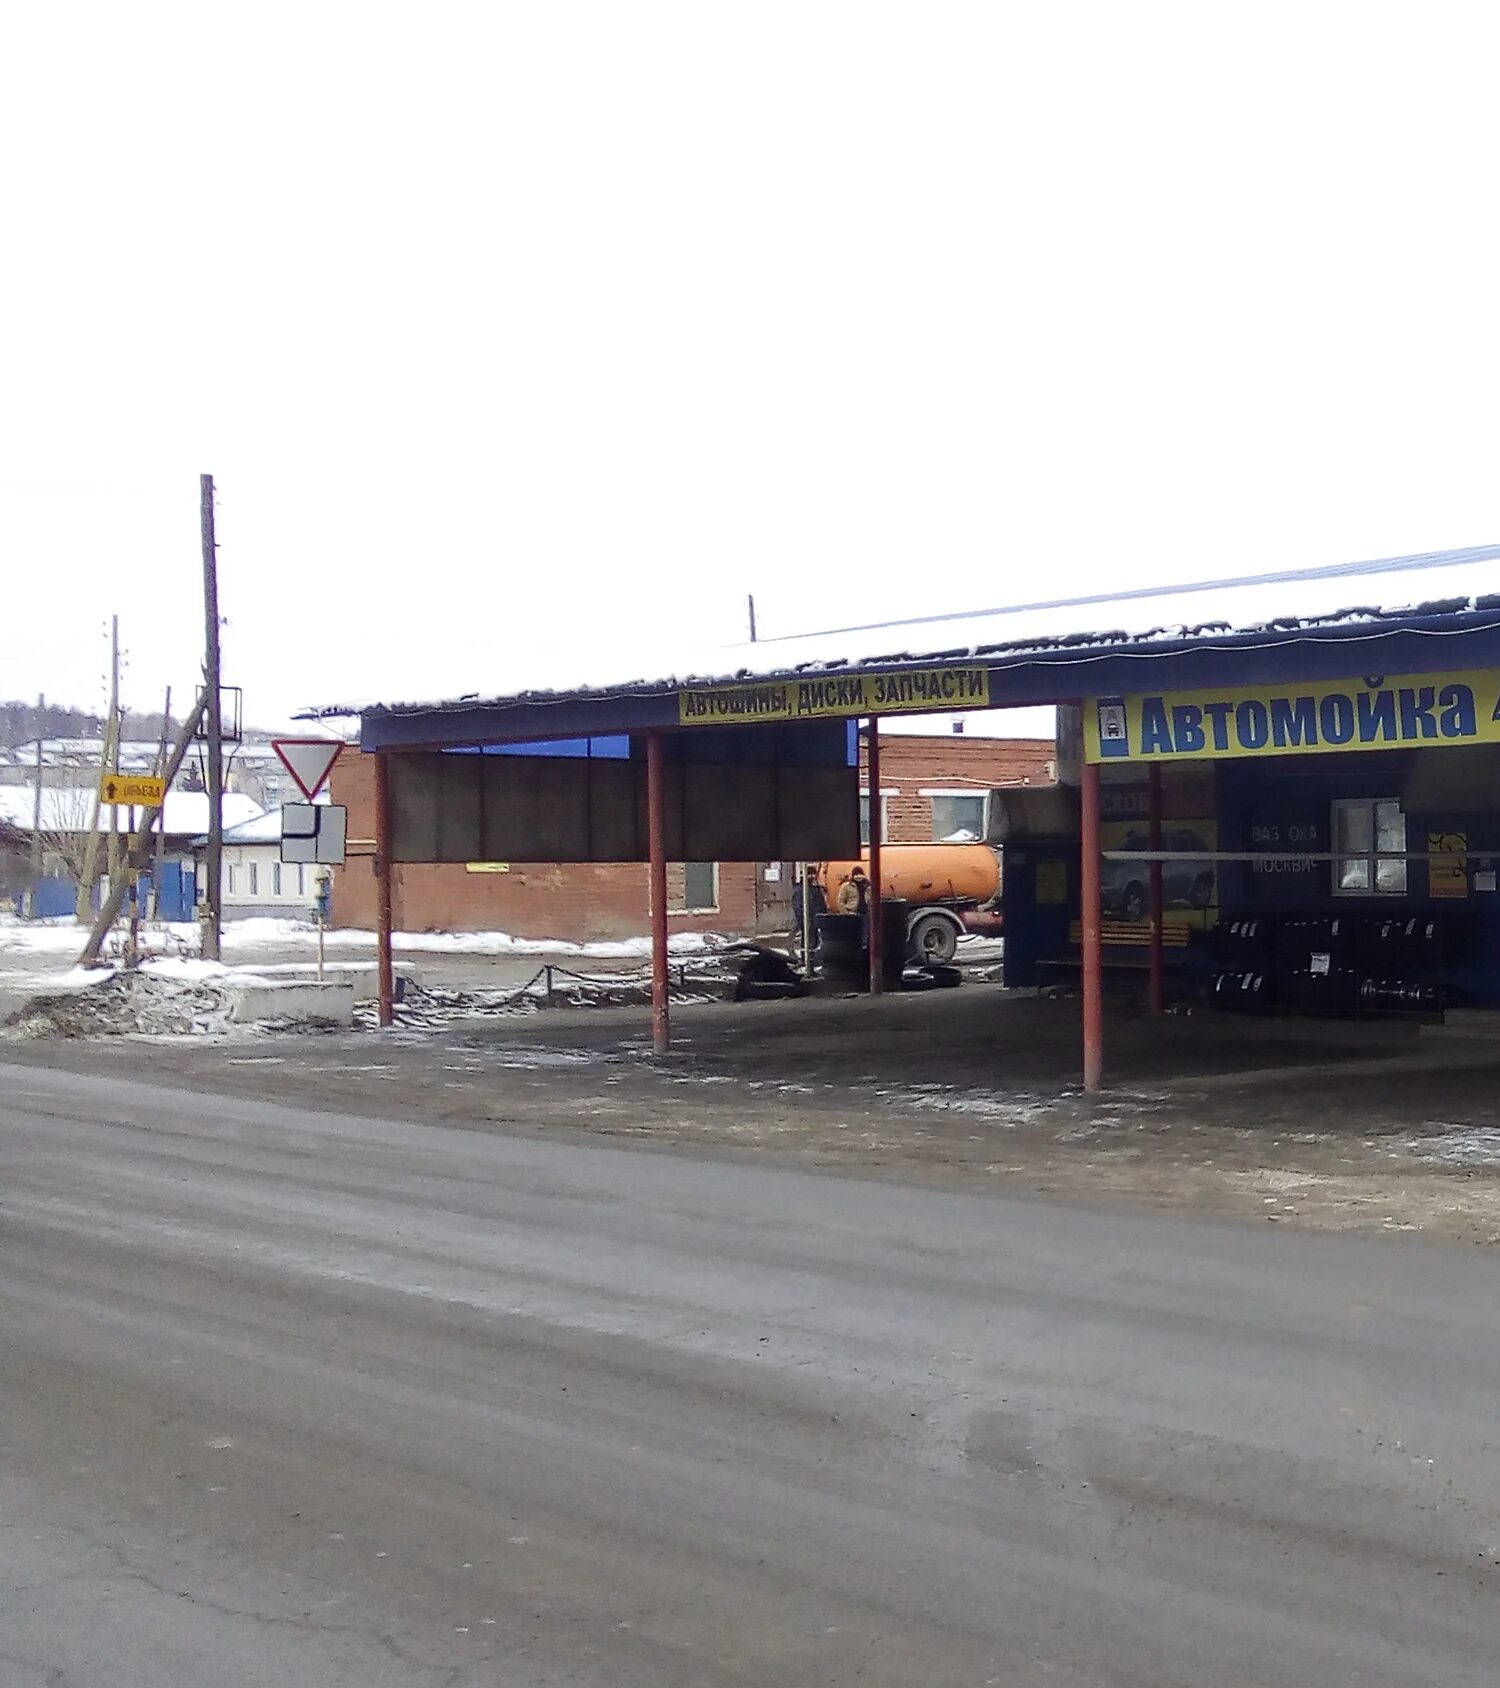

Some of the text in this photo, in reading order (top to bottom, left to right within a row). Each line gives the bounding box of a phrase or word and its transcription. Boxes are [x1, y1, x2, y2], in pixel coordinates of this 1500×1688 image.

[685, 670, 984, 716] АВТОШИНЫ, ДИСКИ, ЗАПЧАСТИ
[1251, 825, 1318, 842] ВАЗ ОКА
